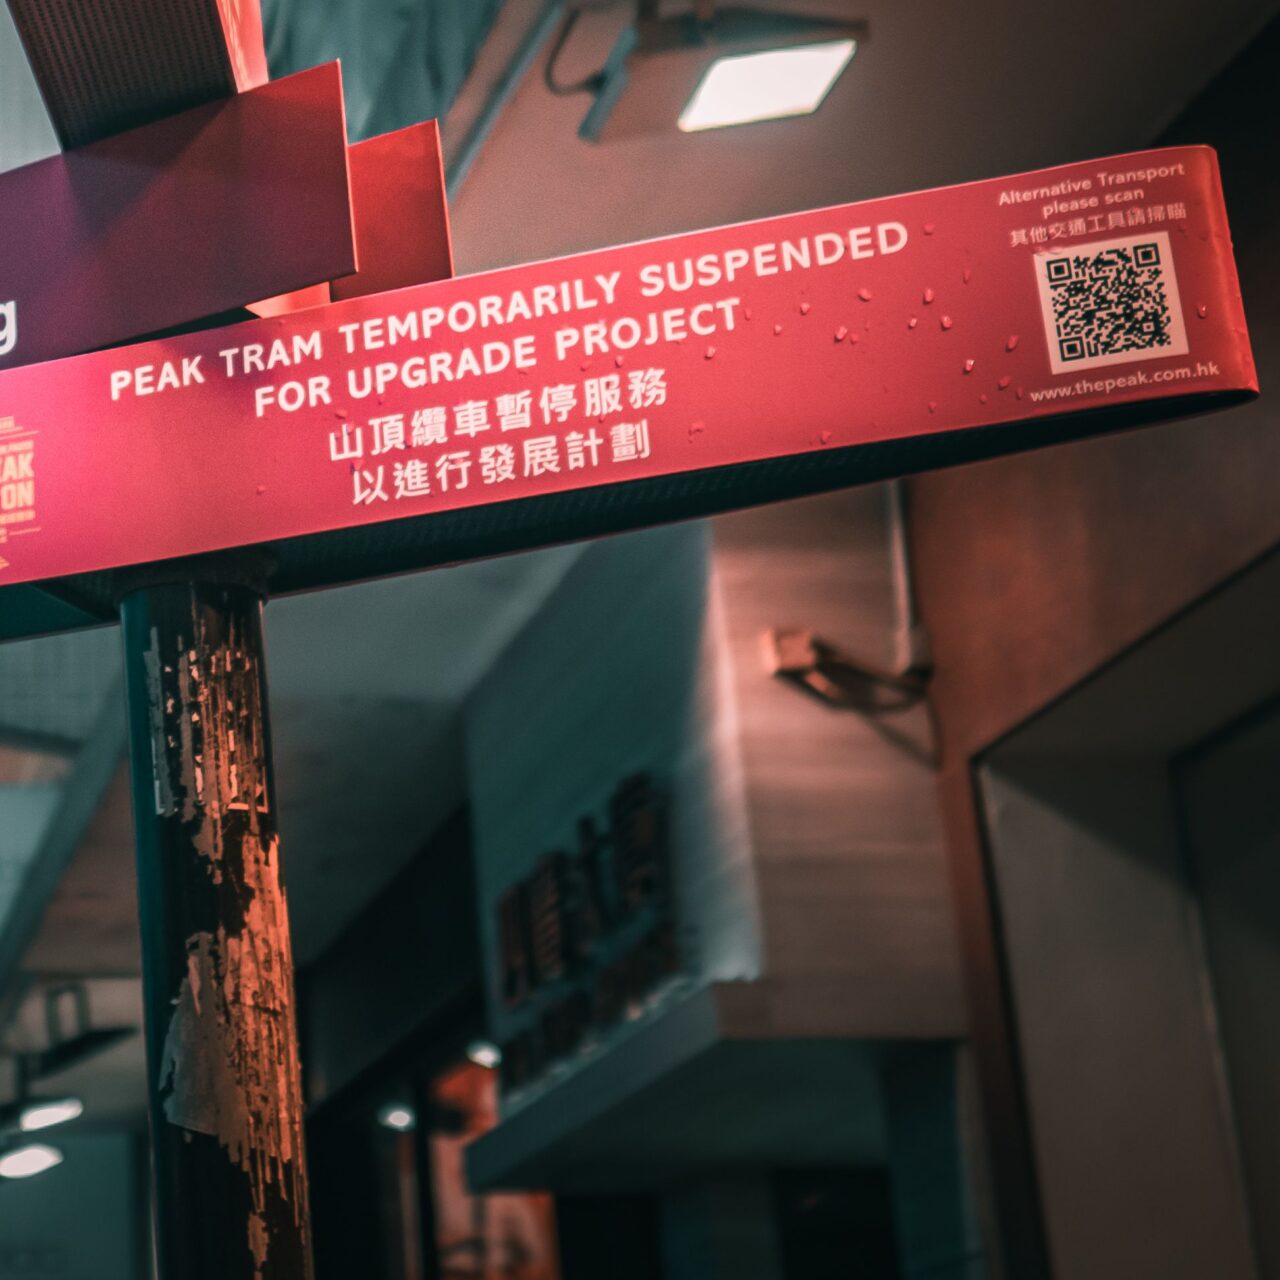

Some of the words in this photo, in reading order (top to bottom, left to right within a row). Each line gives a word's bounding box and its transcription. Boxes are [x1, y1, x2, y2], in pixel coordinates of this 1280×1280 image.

[999, 179, 1093, 206] Alternative
[1096, 163, 1184, 185] Transport
[1042, 195, 1099, 219] please
[1104, 188, 1144, 205] scan
[110, 355, 205, 400] PEAK
[219, 331, 322, 377] TRAM
[338, 271, 621, 353] TEMPORARILY
[639, 221, 908, 297] SUSPENDED
[254, 376, 332, 417] FOR
[348, 335, 537, 399] UPGRADE
[554, 297, 740, 361] PROJECT
[1030, 361, 1220, 402] www.thepeak.com.hk
[329, 368, 667, 461] 山頂纜車暫停服務
[0, 480, 35, 510] ON
[351, 419, 651, 506] 以進行發展計劃
